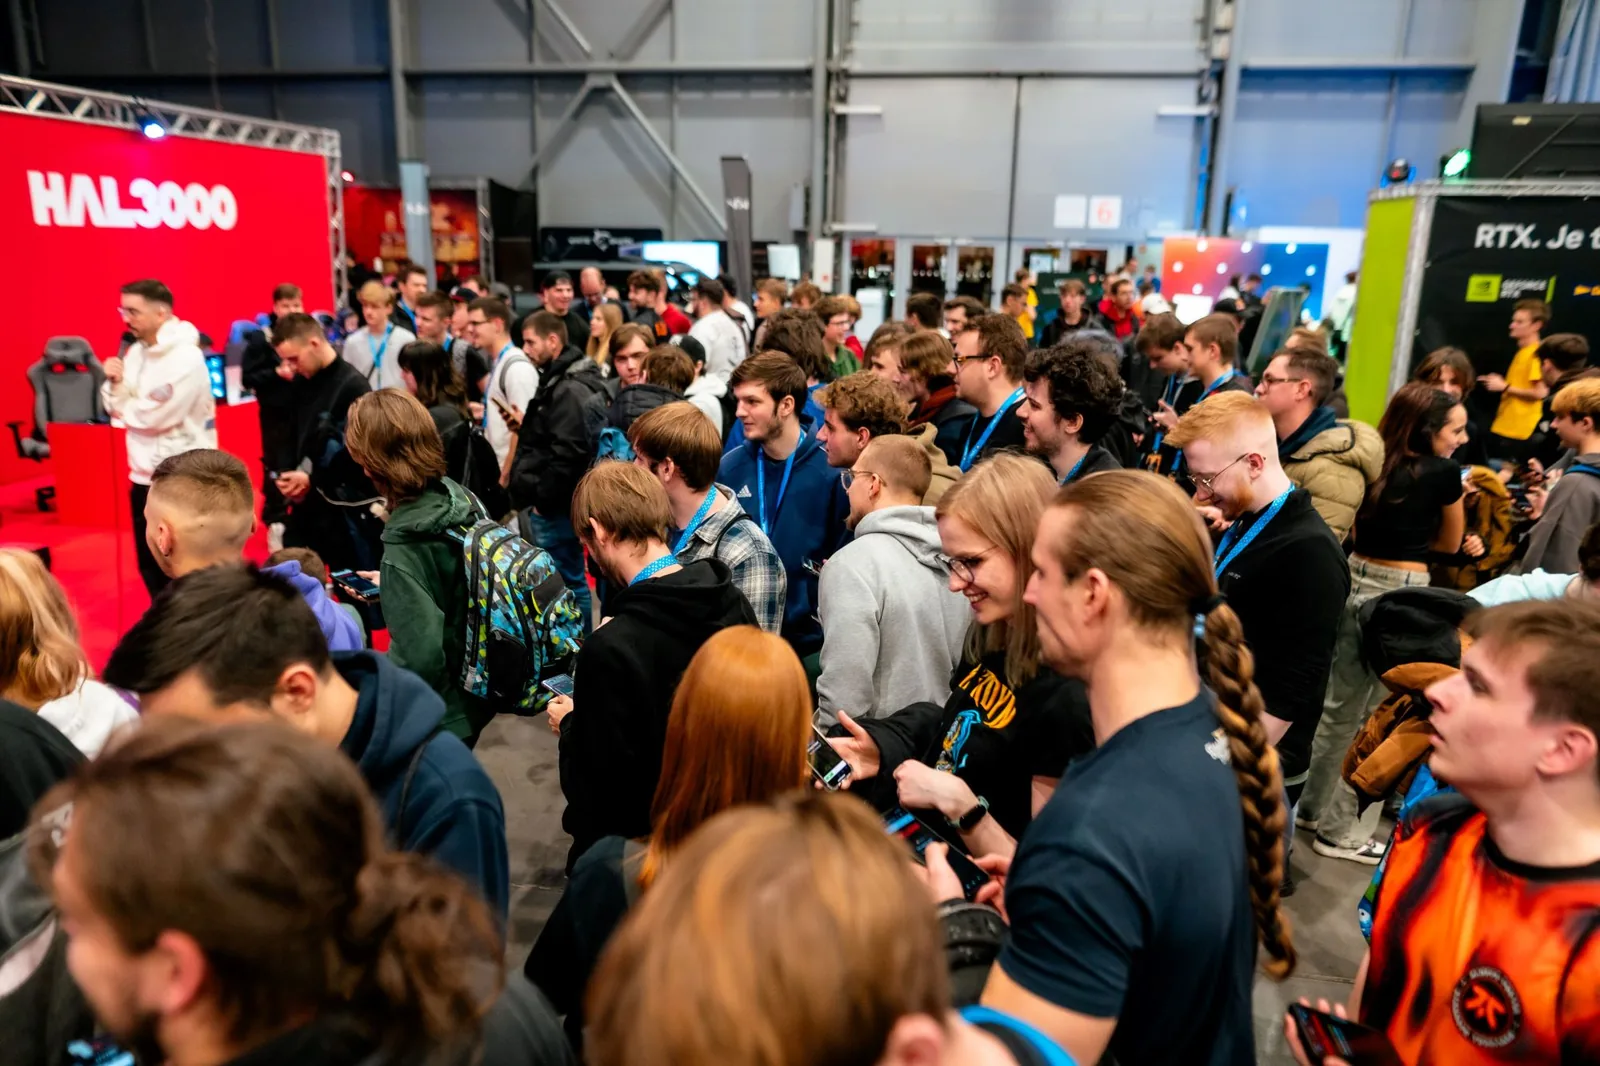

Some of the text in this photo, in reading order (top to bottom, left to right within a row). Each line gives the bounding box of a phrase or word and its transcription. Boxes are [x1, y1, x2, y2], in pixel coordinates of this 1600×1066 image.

[27, 170, 238, 230] HAL3000
[1097, 201, 1113, 224] 6
[1475, 223, 1540, 249] RTX.
[1546, 224, 1585, 250] Je
